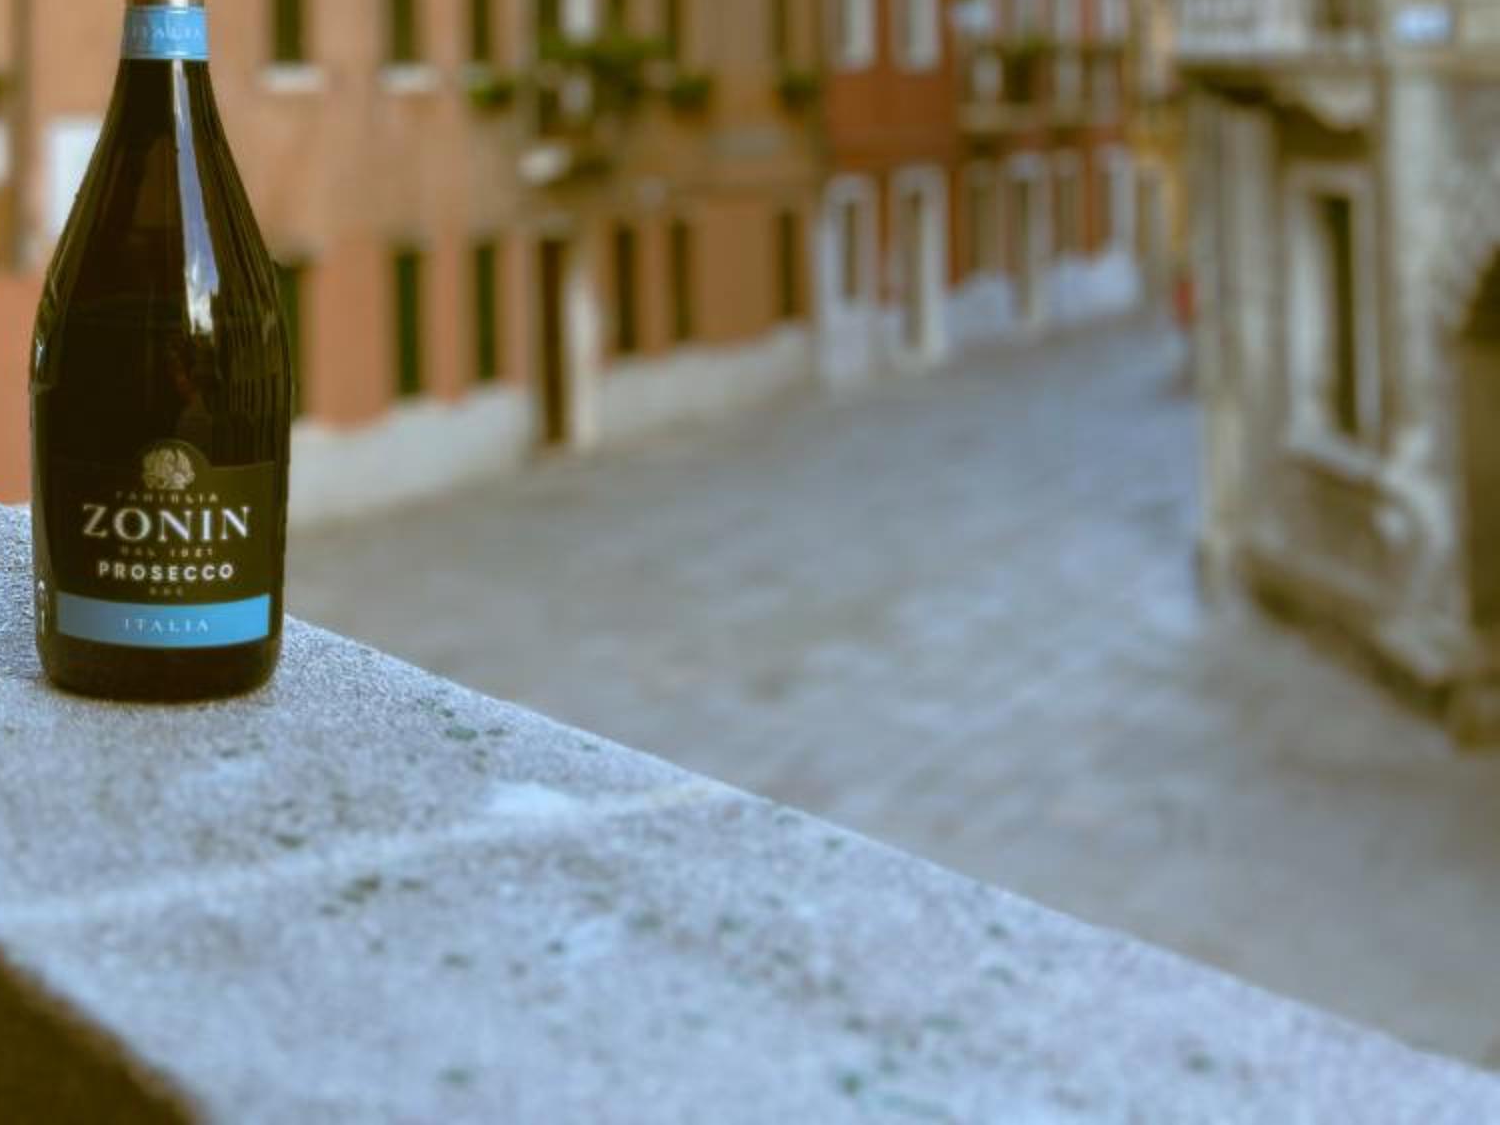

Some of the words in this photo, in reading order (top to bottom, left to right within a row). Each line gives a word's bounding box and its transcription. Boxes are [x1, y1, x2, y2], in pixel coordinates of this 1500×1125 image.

[82, 503, 251, 542] ZONIN
[98, 561, 234, 582] PROSECCO
[123, 618, 209, 634] ITALIA
